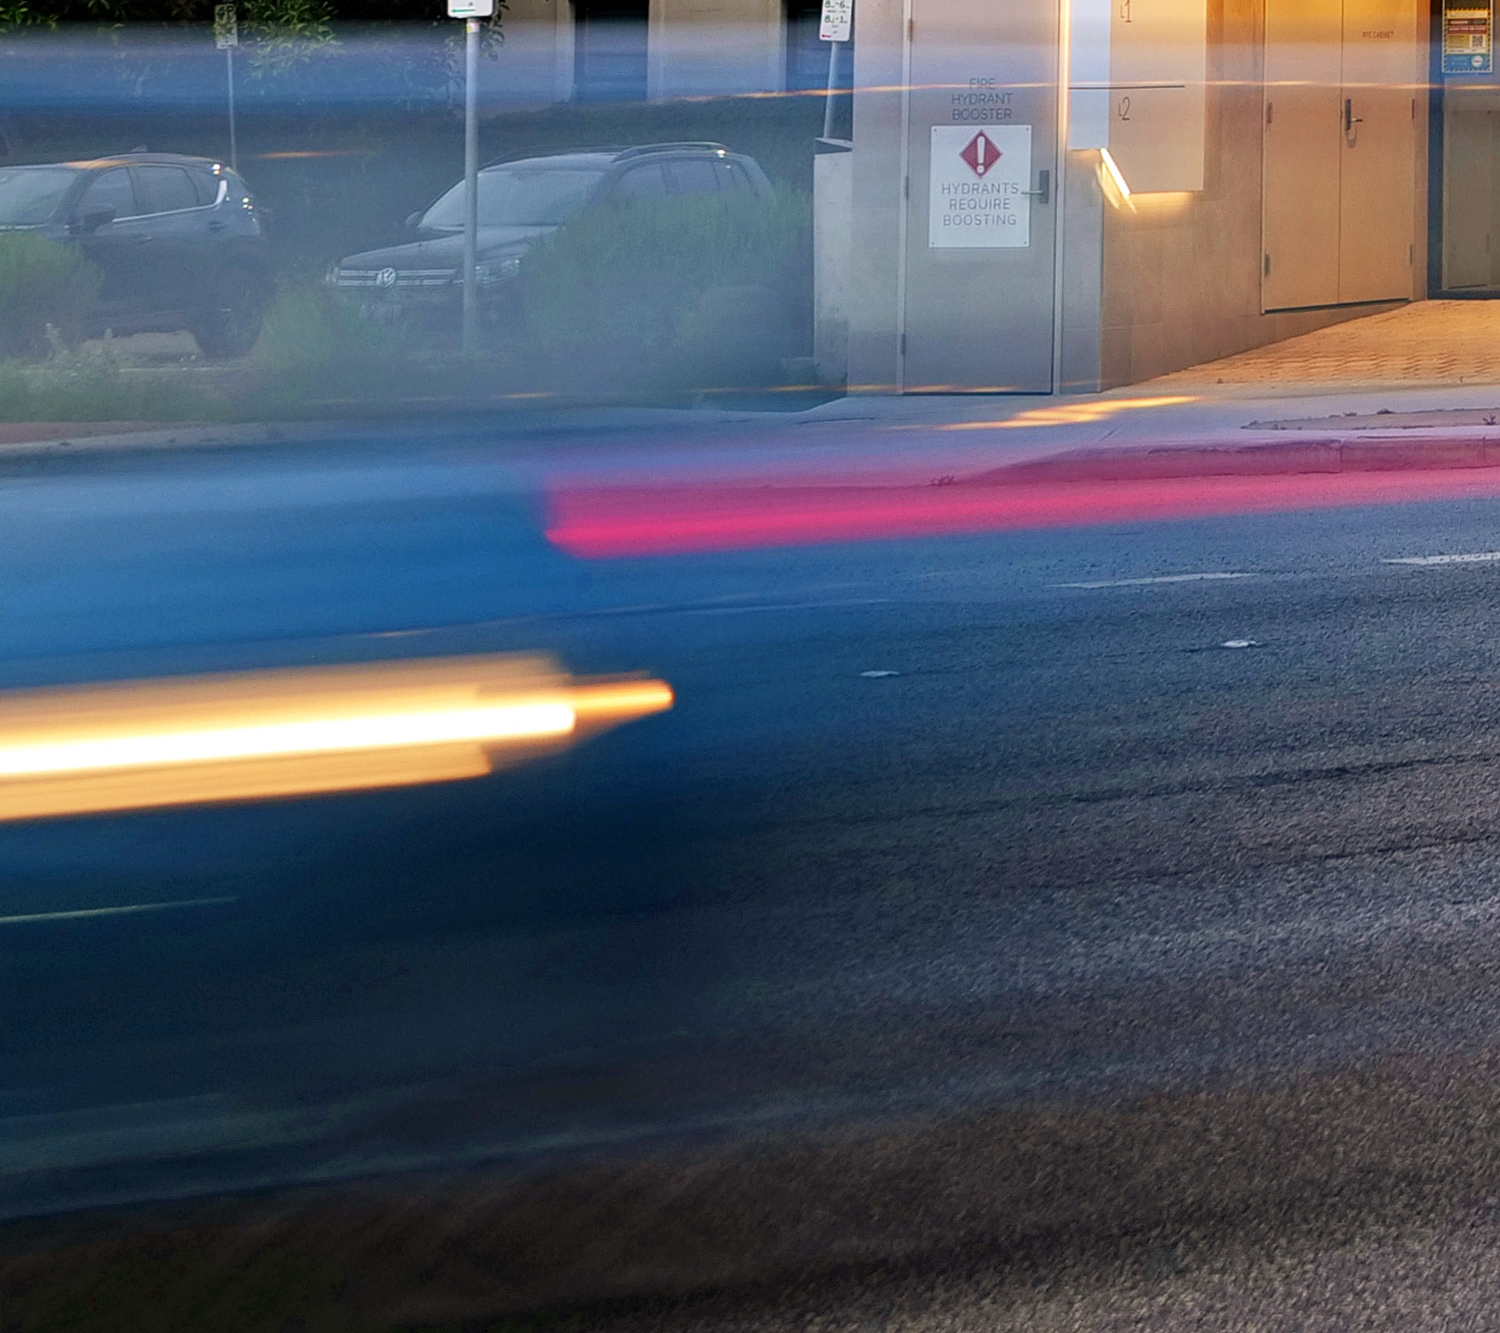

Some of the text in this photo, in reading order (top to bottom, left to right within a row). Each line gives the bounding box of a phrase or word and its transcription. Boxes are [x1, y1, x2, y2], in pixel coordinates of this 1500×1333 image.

[969, 78, 996, 90] FIRE
[951, 93, 1013, 105] HYDRANT
[952, 108, 1013, 120] BOOSTER
[941, 183, 1020, 195] HYDRANTS
[949, 198, 1011, 211] REQUIRE
[943, 214, 1017, 226] BOOSTING
